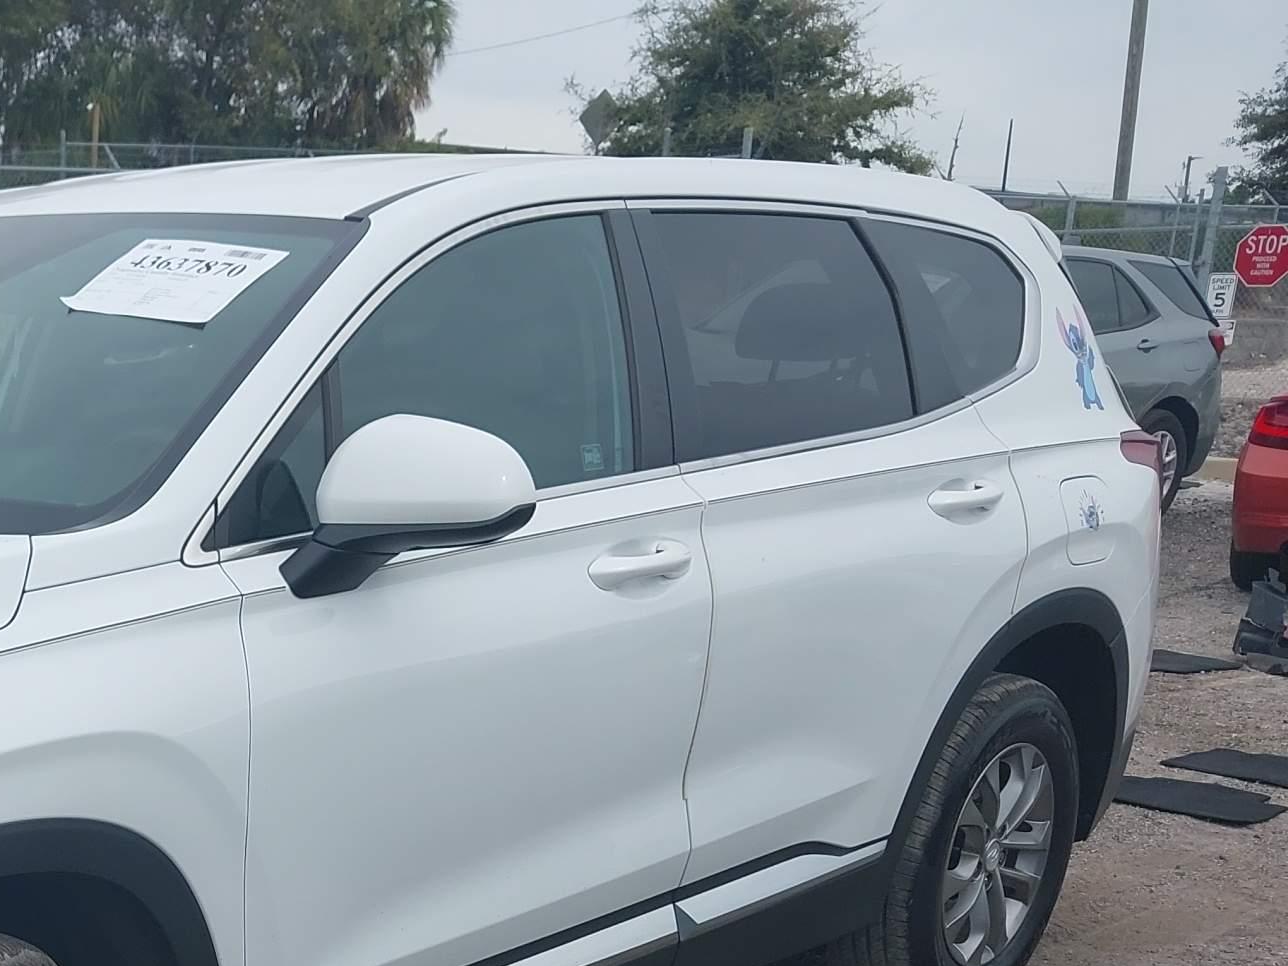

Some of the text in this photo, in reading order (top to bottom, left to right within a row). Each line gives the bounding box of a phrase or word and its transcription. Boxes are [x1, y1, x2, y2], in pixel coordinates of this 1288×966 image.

[1246, 234, 1288, 254] STOP
[130, 255, 248, 278] 43637870
[1213, 292, 1226, 307] 5
